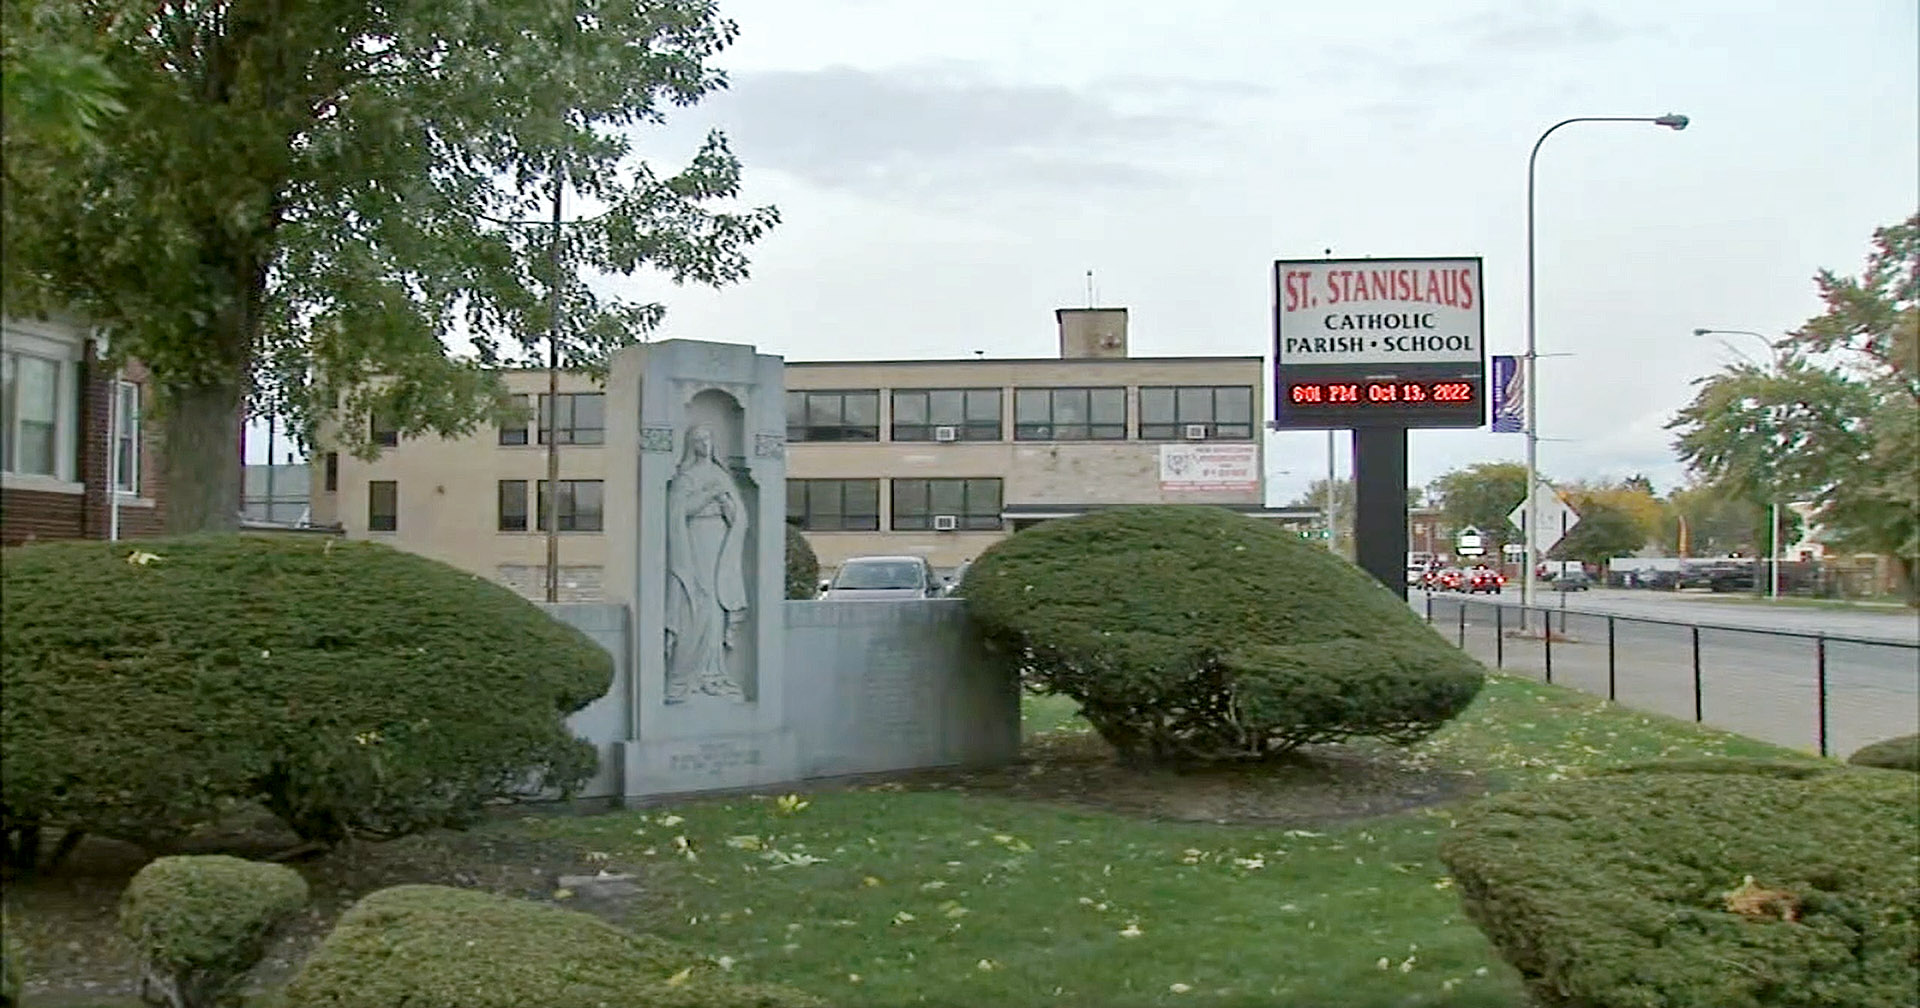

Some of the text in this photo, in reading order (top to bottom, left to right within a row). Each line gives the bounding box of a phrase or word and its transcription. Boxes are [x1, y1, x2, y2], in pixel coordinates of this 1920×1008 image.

[1286, 269, 1473, 312] ST. STANISLAUS
[1325, 313, 1436, 330] CATHOLIC
[1286, 335, 1474, 353] PARISH SCHOOL
[1329, 385, 1357, 401] PM
[1368, 384, 1397, 401] Oct
[1403, 384, 1426, 401] 13,
[1433, 383, 1471, 400] 2022
